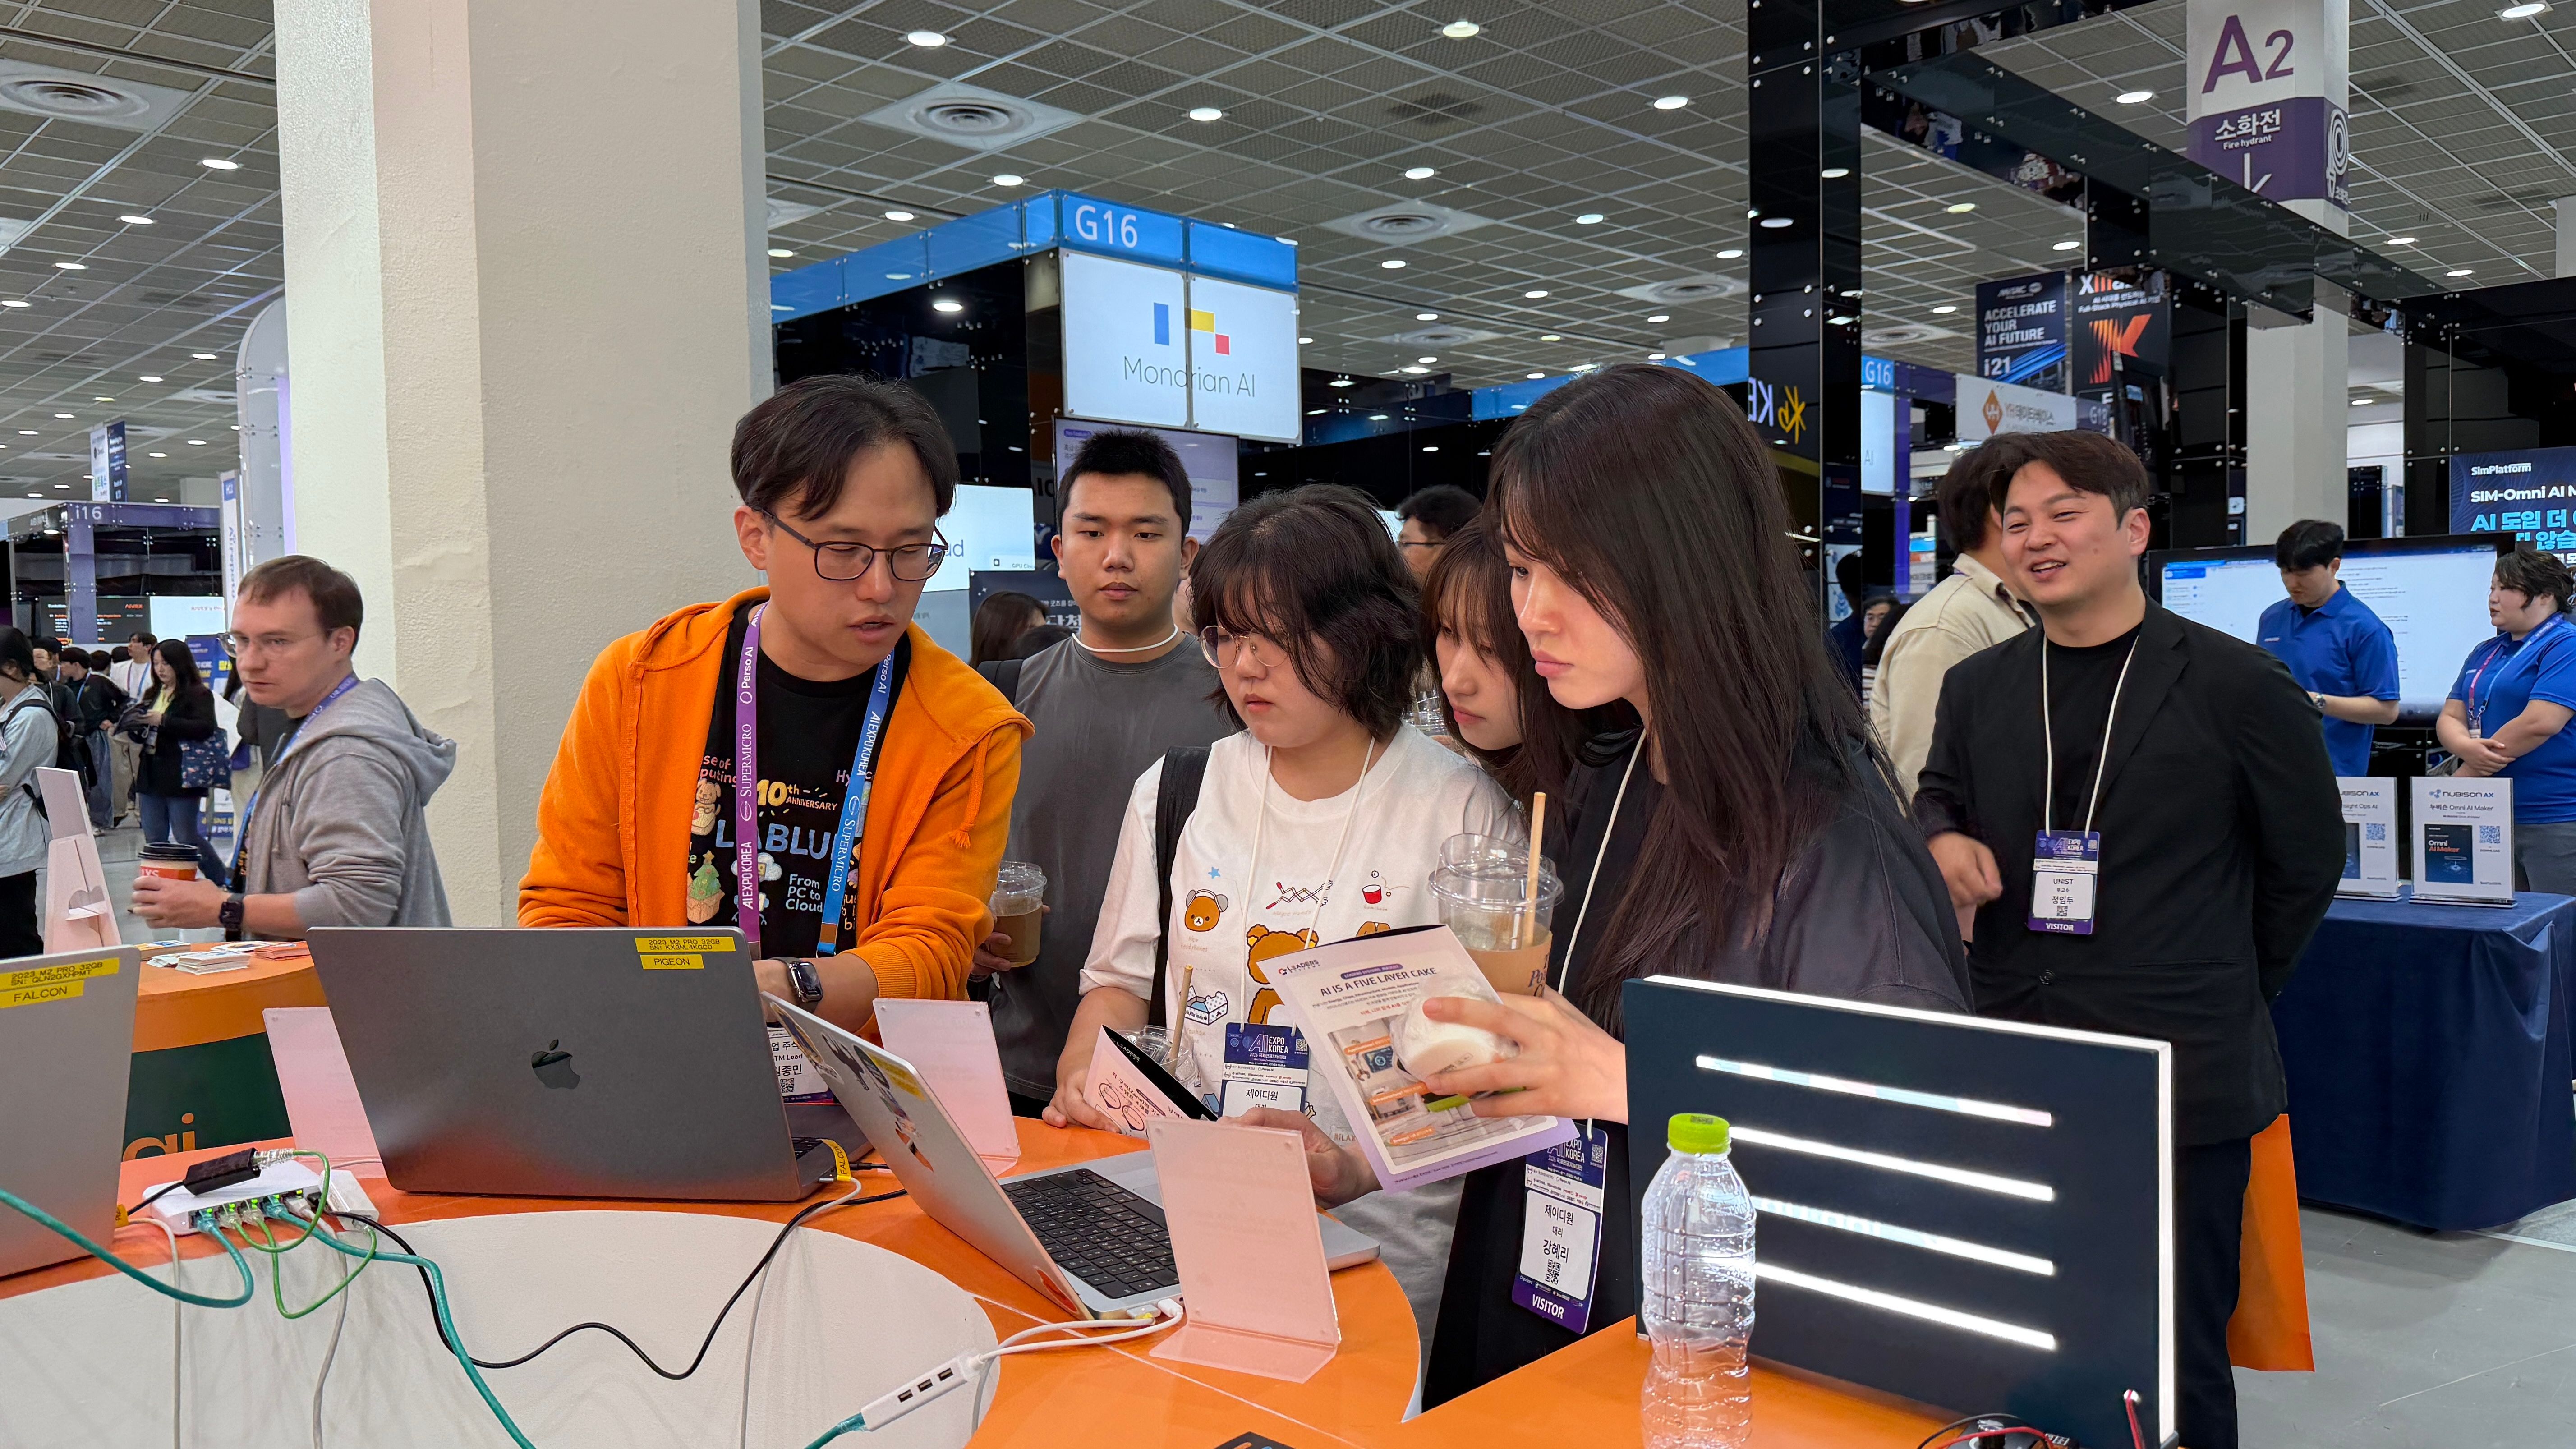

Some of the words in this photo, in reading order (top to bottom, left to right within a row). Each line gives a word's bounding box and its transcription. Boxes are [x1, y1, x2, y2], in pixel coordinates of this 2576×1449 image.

[2215, 109, 2281, 141] 소화전
[2223, 141, 2240, 150] Fire
[2240, 134, 2272, 147] hydrant
[1075, 205, 1138, 248] G16
[1985, 300, 2056, 322] ACCELERATE
[1985, 319, 2017, 334] YOUR
[1985, 335, 1996, 346] AI
[1999, 327, 2045, 345] FUTURE
[1124, 356, 1230, 394] Mondrian
[1237, 373, 1256, 397] AI
[1864, 361, 1891, 385] G16
[2471, 463, 2531, 476] SimPlatform
[2471, 486, 2546, 503] SIM-Omni
[2548, 486, 2565, 498] AI
[75, 505, 102, 520] i16
[2470, 513, 2496, 532] AI
[2501, 510, 2541, 530] 도입
[2547, 509, 2567, 528] 더
[745, 646, 754, 658] AI
[741, 661, 752, 689] Perso
[878, 681, 887, 694] AI
[719, 758, 731, 770] of
[740, 724, 752, 797] SUPERMICRO
[786, 796, 838, 811] ANNIVERSARY
[715, 819, 838, 860] LBLU
[832, 819, 856, 891] SUPERMICRO
[789, 874, 820, 889] From
[788, 886, 806, 898] PC
[809, 889, 821, 901] to
[785, 899, 823, 913] Cloud
[2046, 923, 2074, 931] VISITOR
[11, 971, 35, 980] 2023
[79, 962, 103, 970] 32GB
[1320, 987, 1332, 996] AI
[1334, 985, 1343, 994] IS
[1345, 983, 1353, 991] A
[1353, 977, 1377, 989] FIVE
[1378, 970, 1410, 983] LAYER
[1411, 967, 1437, 978] CAKE
[14, 986, 68, 1002] FALCON
[1248, 1034, 1269, 1053] AI
[1269, 1036, 1285, 1045] EXPO
[1268, 1044, 1288, 1054] KOREA
[1246, 1089, 1278, 1101] 제이디원
[1565, 1148, 1585, 1164] KOREA
[1545, 1205, 1573, 1225] 제이디원
[1552, 1226, 1563, 1237] 대리
[1543, 1240, 1569, 1263] 강혜리
[1532, 1294, 1564, 1320] VISITOR
